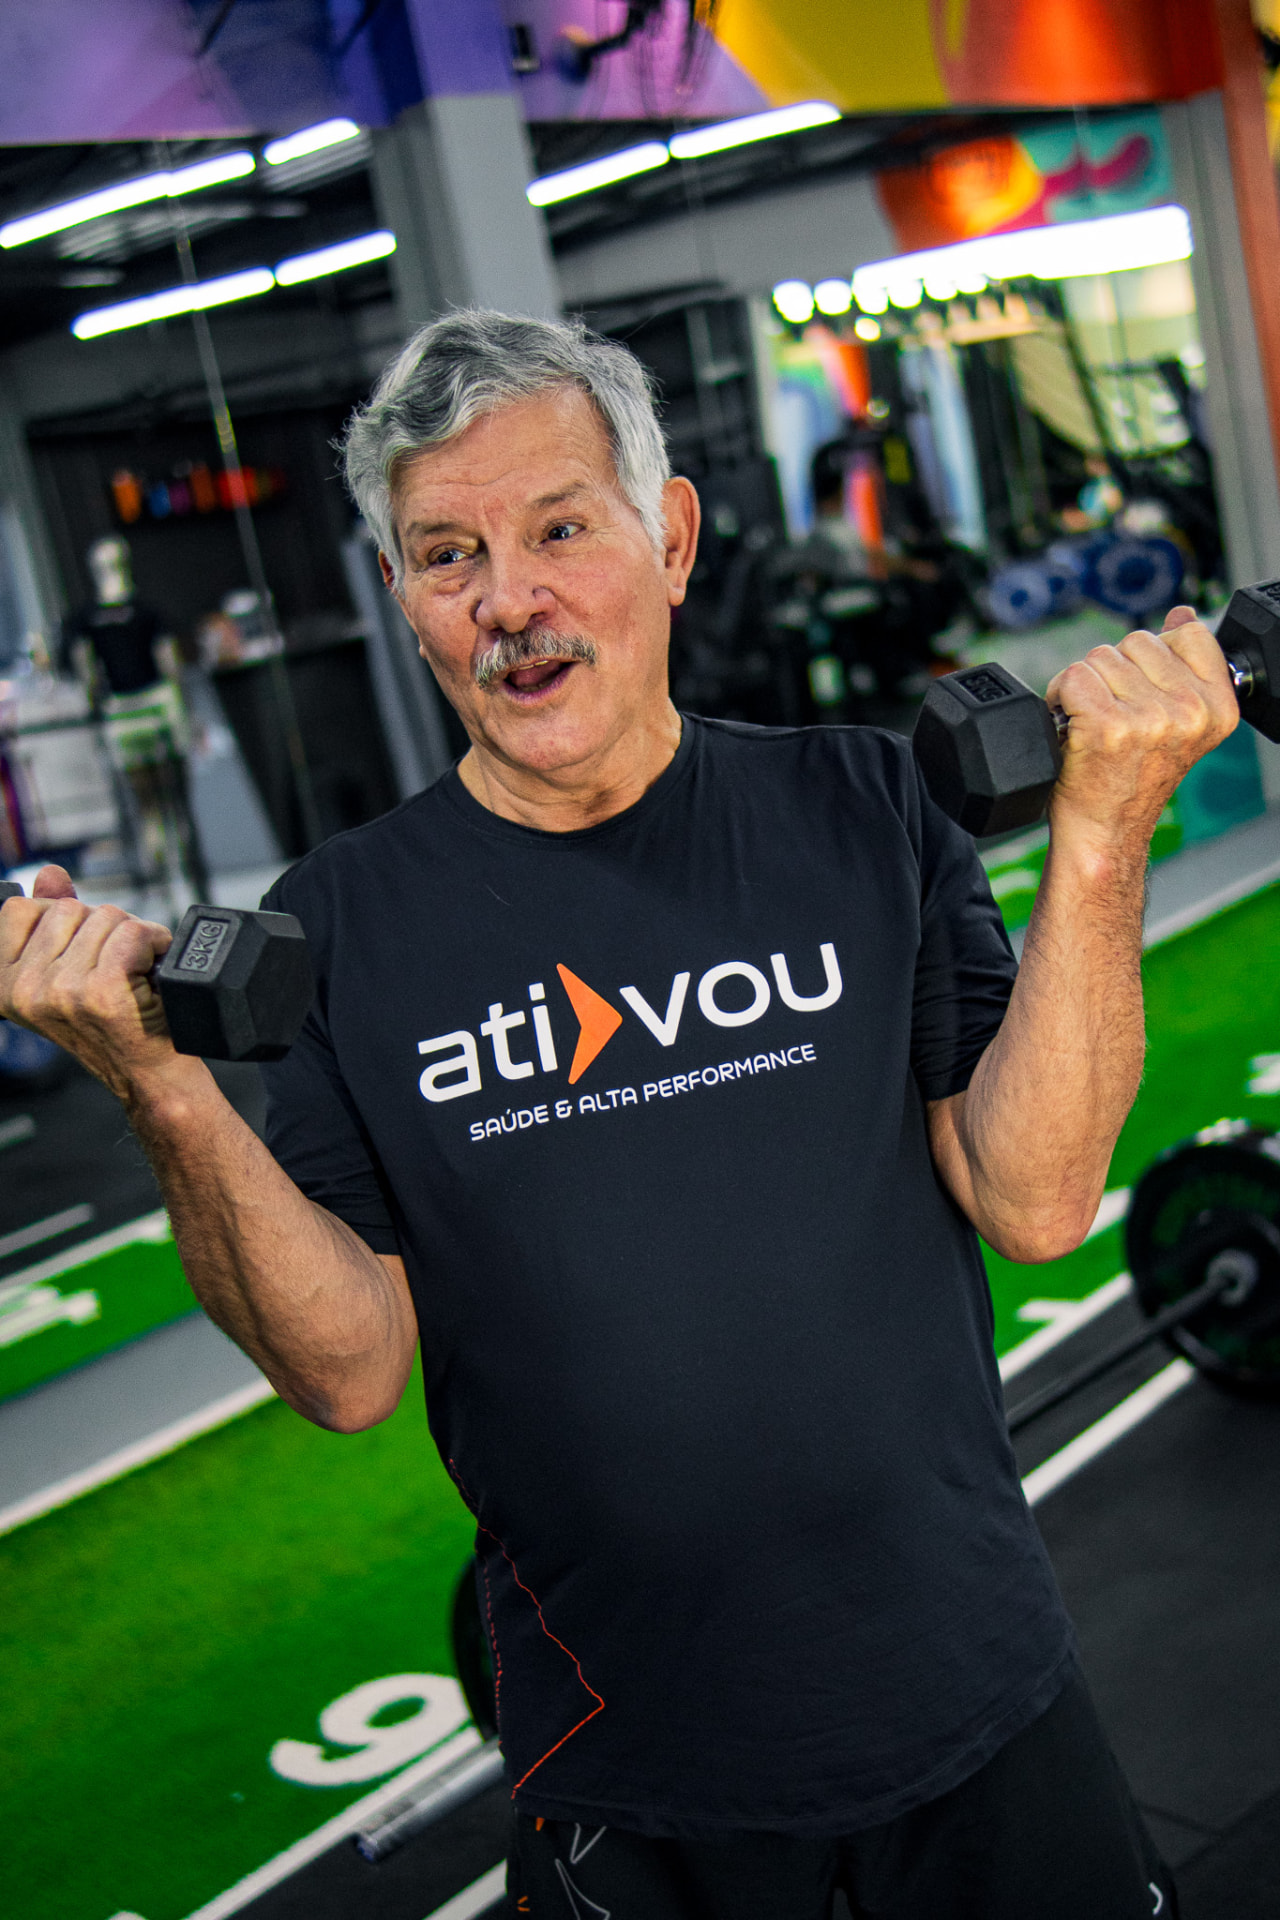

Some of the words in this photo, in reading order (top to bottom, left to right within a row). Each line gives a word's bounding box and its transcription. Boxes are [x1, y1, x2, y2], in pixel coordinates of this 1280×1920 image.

[186, 923, 223, 969] 3KG
[470, 1104, 549, 1141] SAÚDE
[555, 1100, 573, 1118] &
[579, 1087, 639, 1114] ALTA
[643, 1043, 817, 1101] PERFORMANCE
